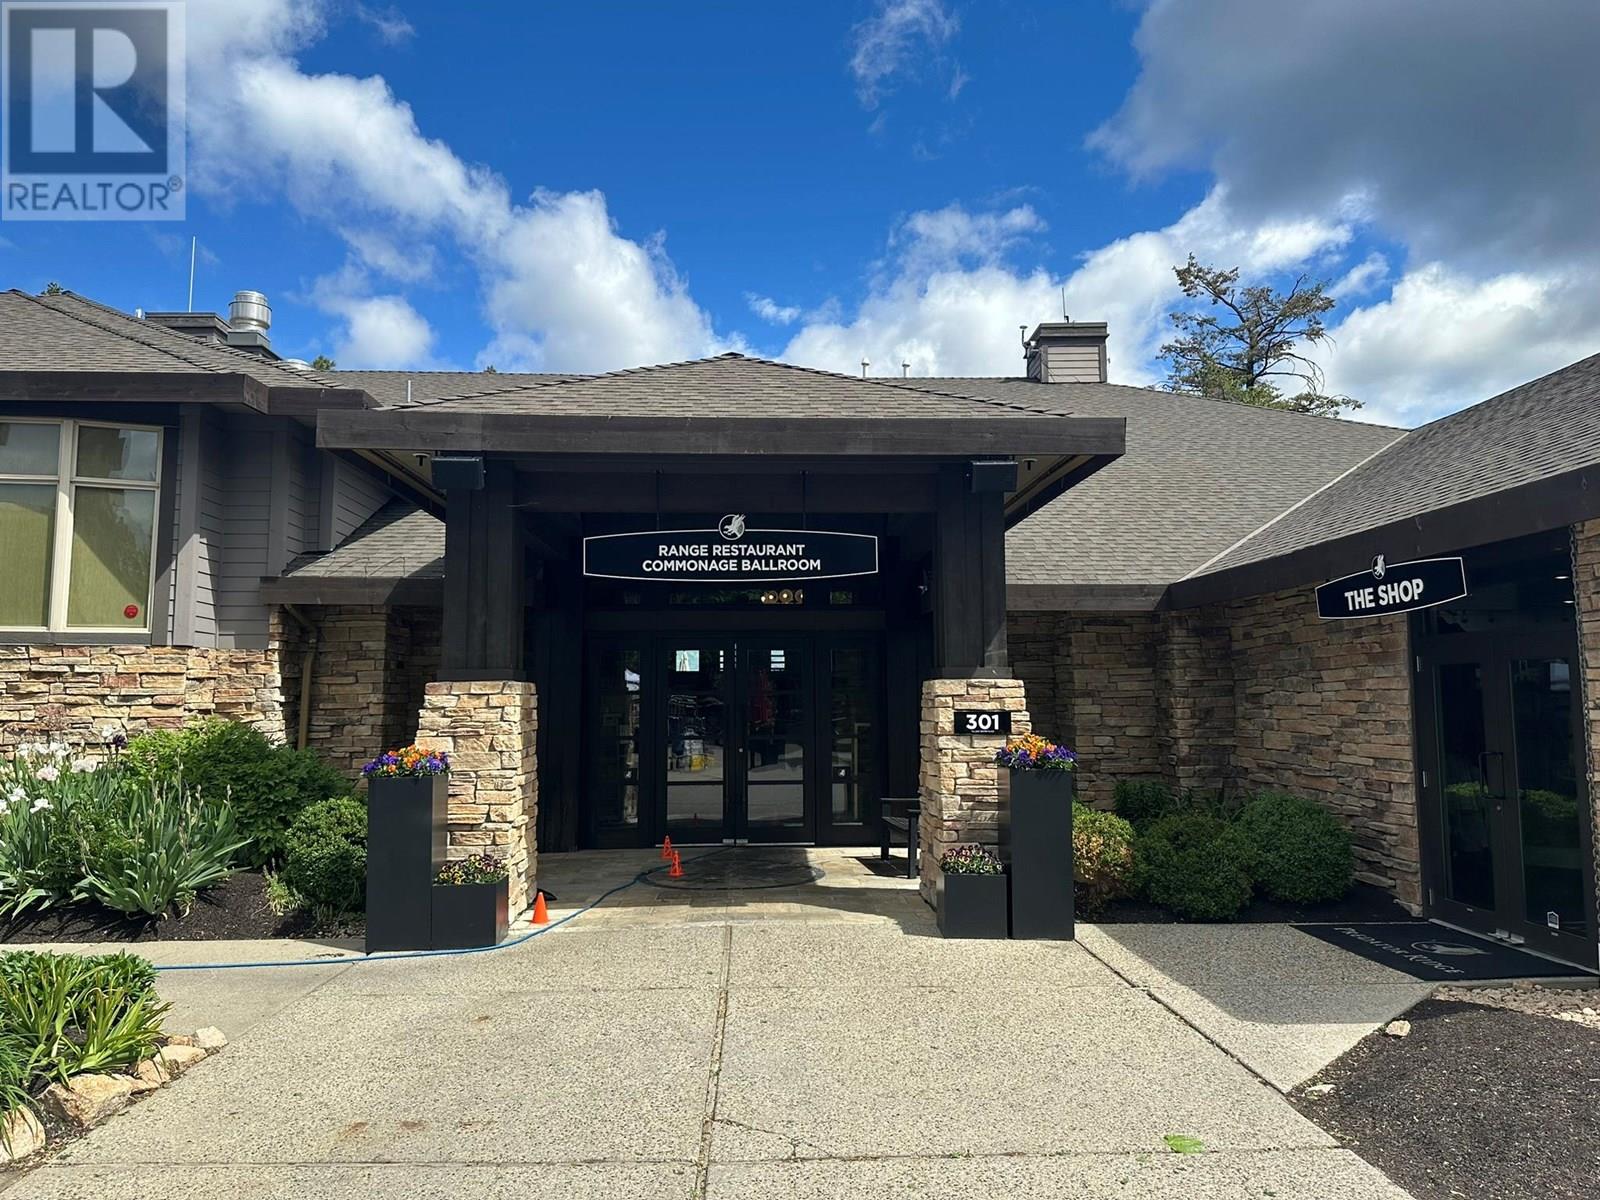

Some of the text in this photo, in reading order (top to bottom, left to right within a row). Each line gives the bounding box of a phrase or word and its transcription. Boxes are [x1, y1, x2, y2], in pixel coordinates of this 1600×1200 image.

[658, 544, 805, 556] RANGE RESTAURANT
[642, 559, 821, 572] COMMONAGE BALLROOM
[1344, 578, 1424, 611] THE SHOP
[966, 714, 999, 730] 301
